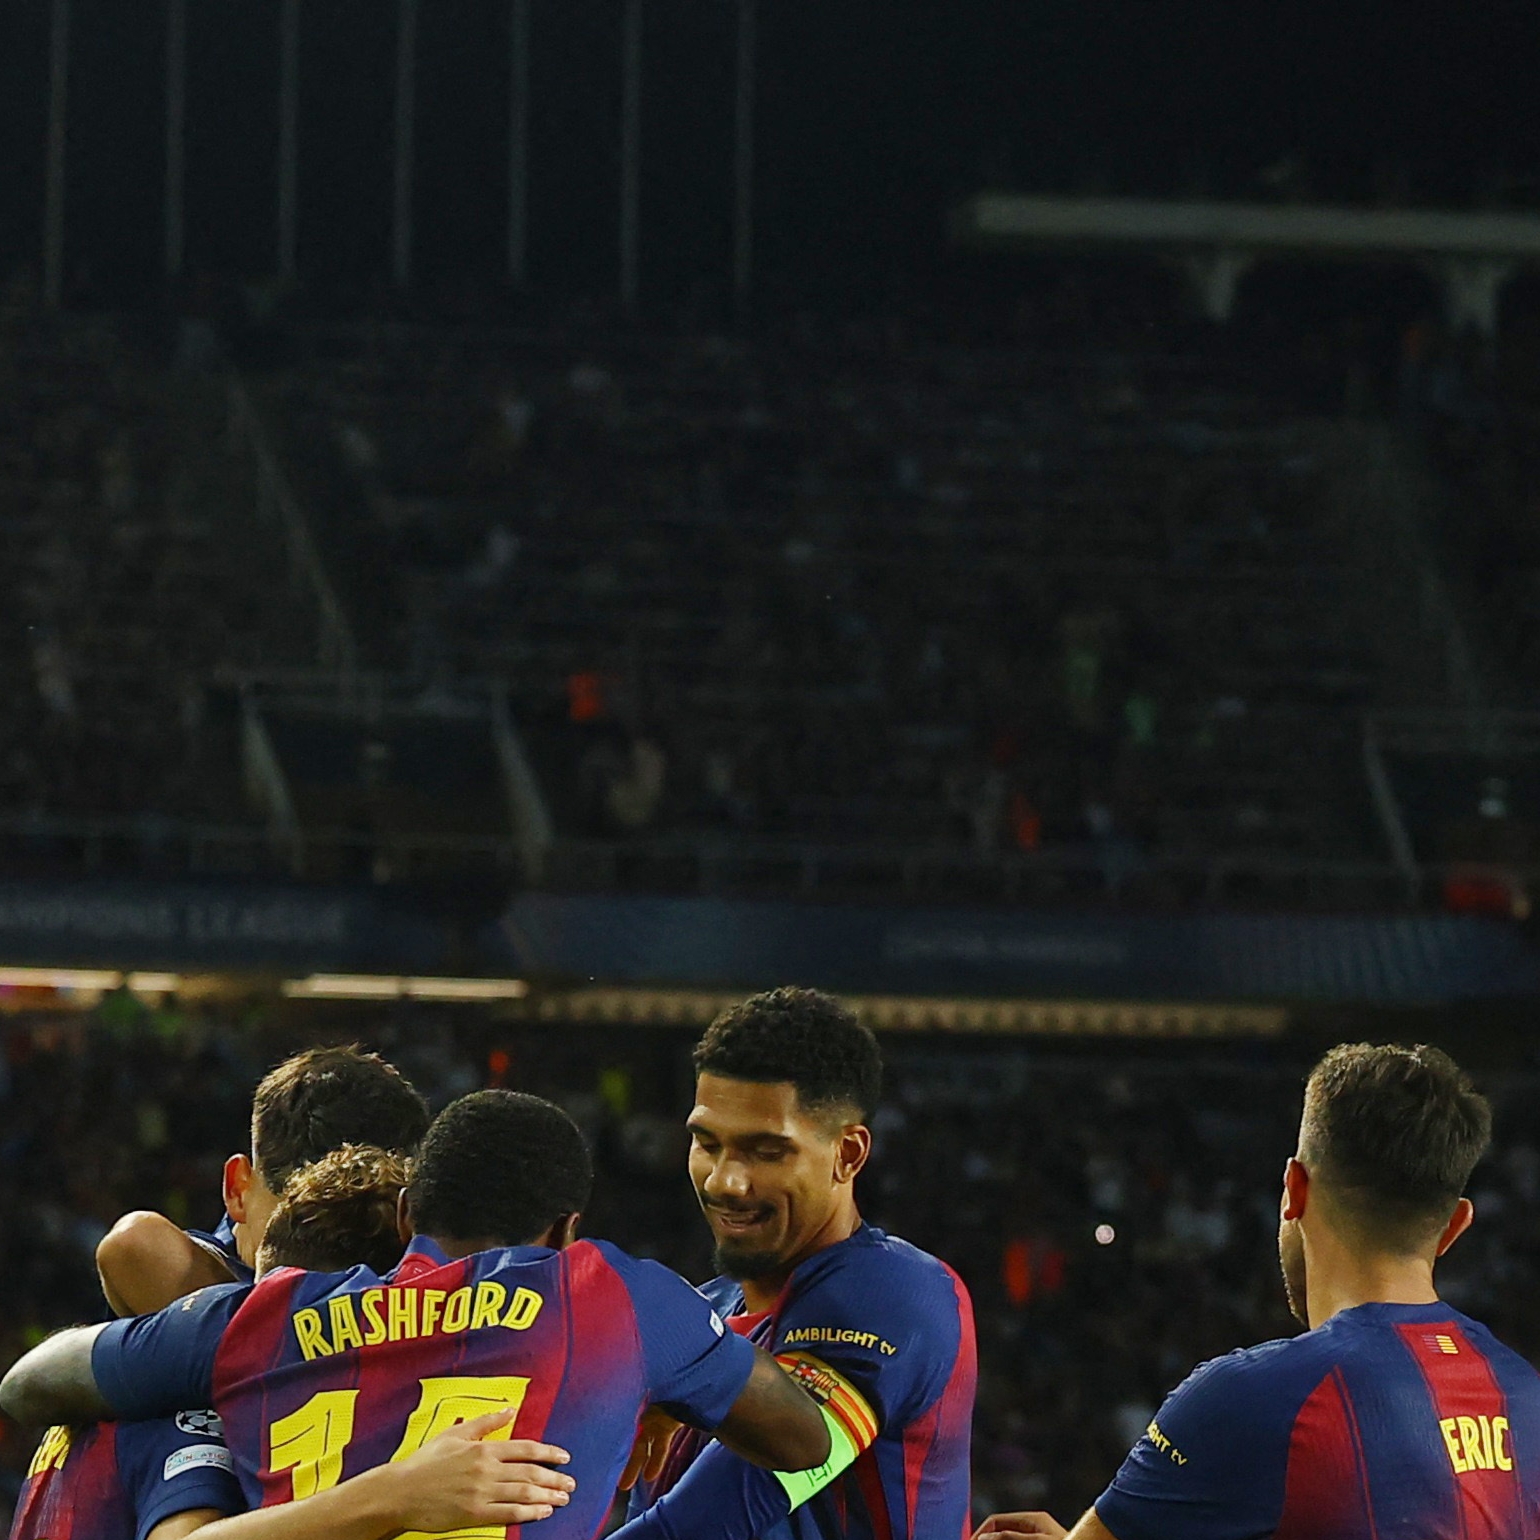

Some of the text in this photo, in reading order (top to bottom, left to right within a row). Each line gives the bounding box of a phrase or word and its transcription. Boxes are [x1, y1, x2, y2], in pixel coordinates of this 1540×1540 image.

[293, 1281, 543, 1361] RASHFORD
[784, 1327, 897, 1356] AMBILIGHT tv
[1439, 1415, 1513, 1474] ERIC
